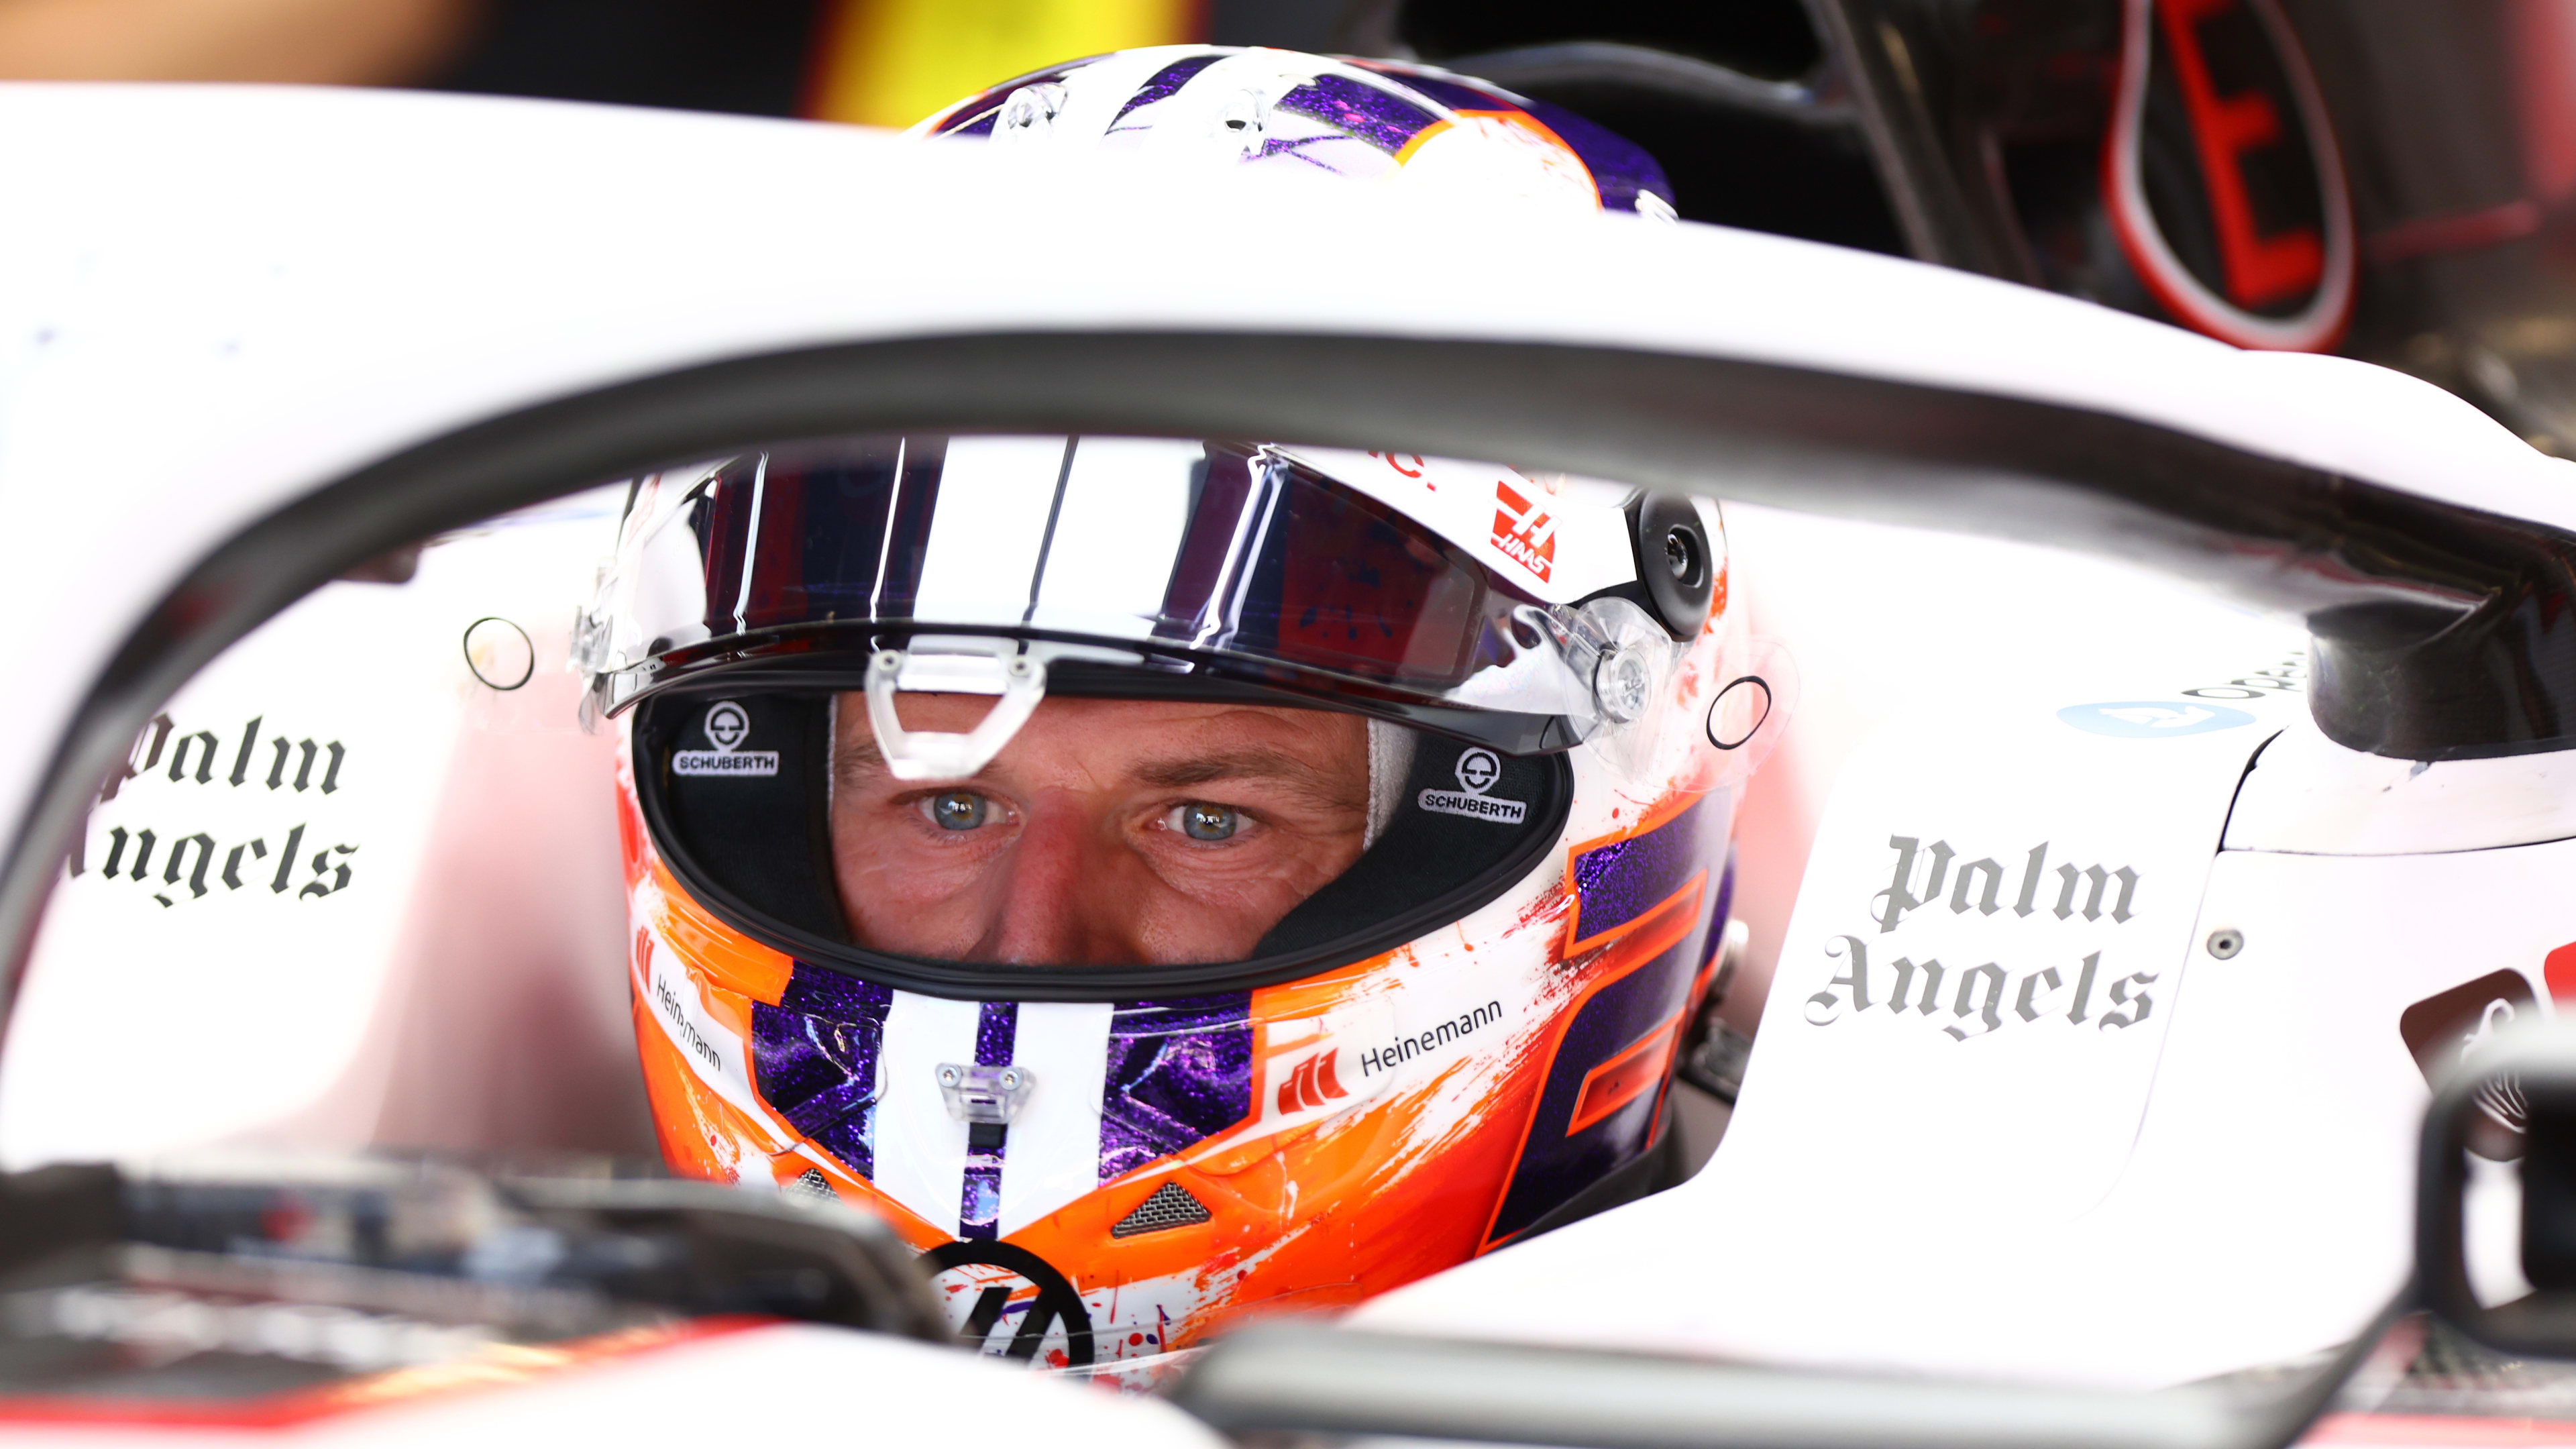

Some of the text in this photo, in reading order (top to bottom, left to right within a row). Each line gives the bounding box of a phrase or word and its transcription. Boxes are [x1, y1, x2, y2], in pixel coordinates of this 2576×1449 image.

[1490, 532, 1554, 574] HAAS
[679, 755, 775, 770] SCHUBERTH
[1425, 794, 1523, 818] SCHUBERTH
[1870, 833, 2143, 934] Palm
[1805, 934, 2159, 1042] Angels
[1361, 1000, 1503, 1077] Heinemann
